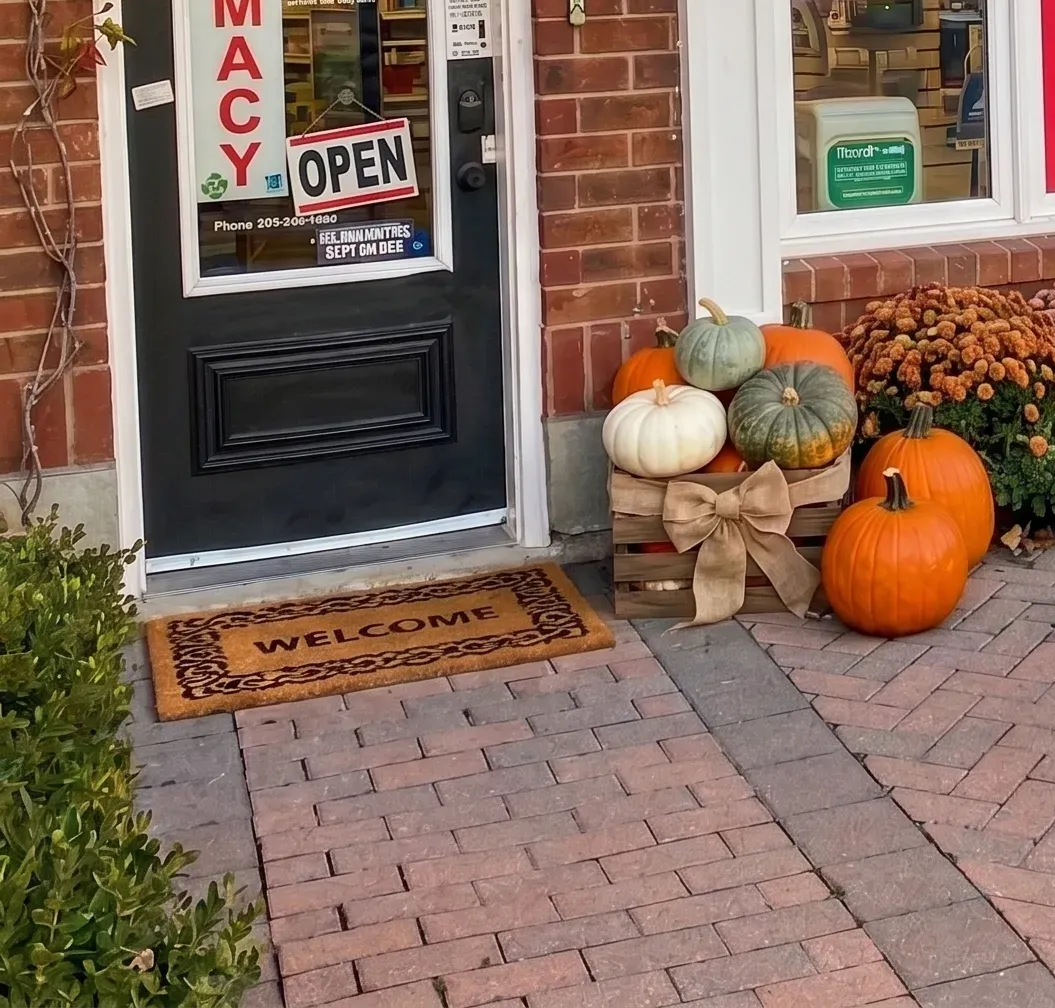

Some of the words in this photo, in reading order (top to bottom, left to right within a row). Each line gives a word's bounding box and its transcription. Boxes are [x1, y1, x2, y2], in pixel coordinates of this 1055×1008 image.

[298, 135, 408, 198] OPEN
[214, 220, 253, 232] Phone
[325, 244, 357, 260] SEPT
[252, 606, 500, 655] WELCOME
